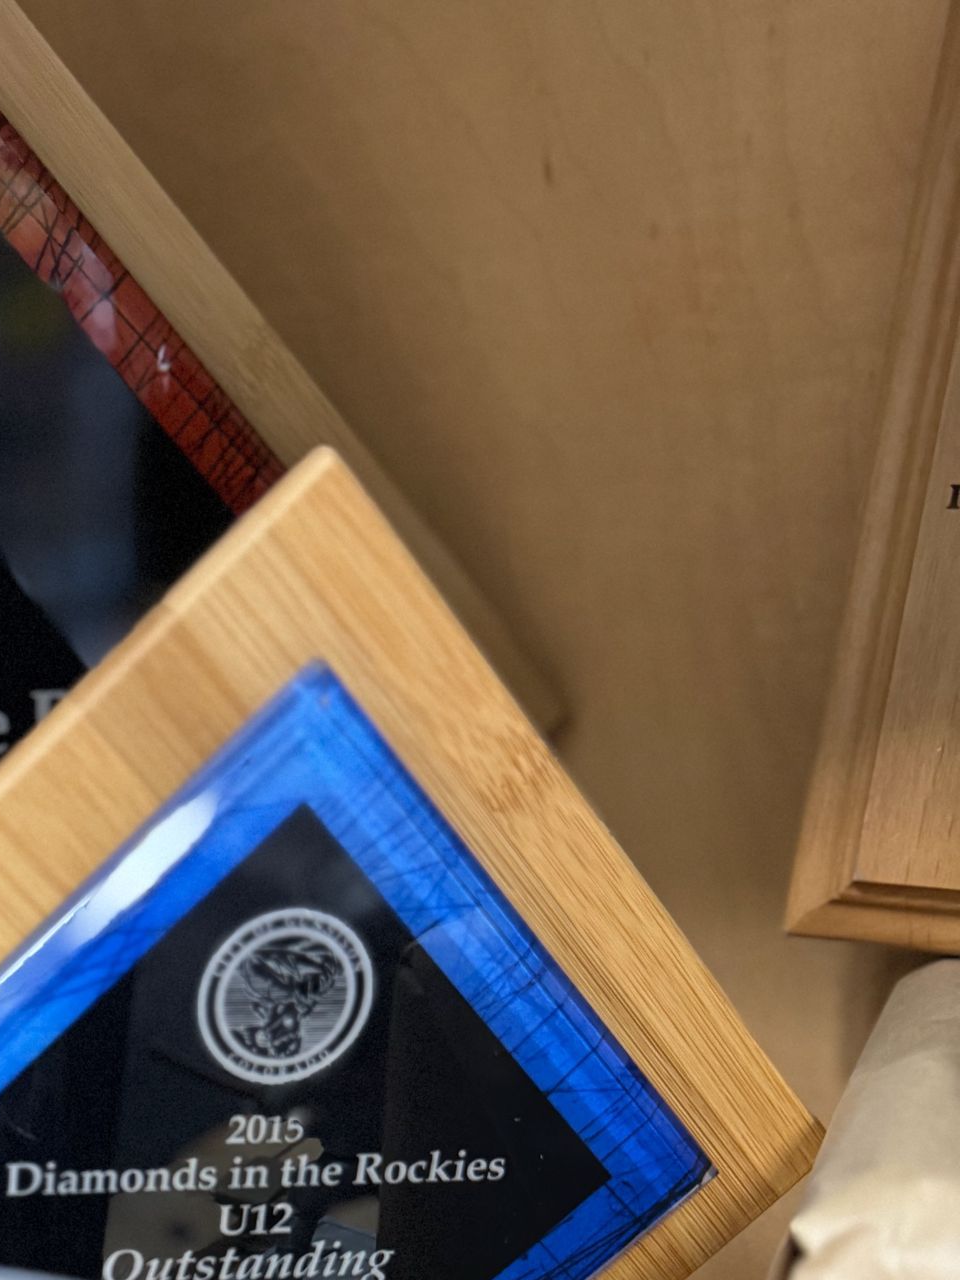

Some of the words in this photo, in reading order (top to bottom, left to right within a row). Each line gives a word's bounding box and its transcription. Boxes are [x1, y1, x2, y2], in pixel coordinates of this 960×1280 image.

[225, 1114, 305, 1145] 2015
[5, 1158, 218, 1197] Diamonds
[230, 1157, 269, 1189] in
[279, 1152, 343, 1187] the
[352, 1149, 506, 1186] Rockies
[218, 1203, 293, 1236] U12
